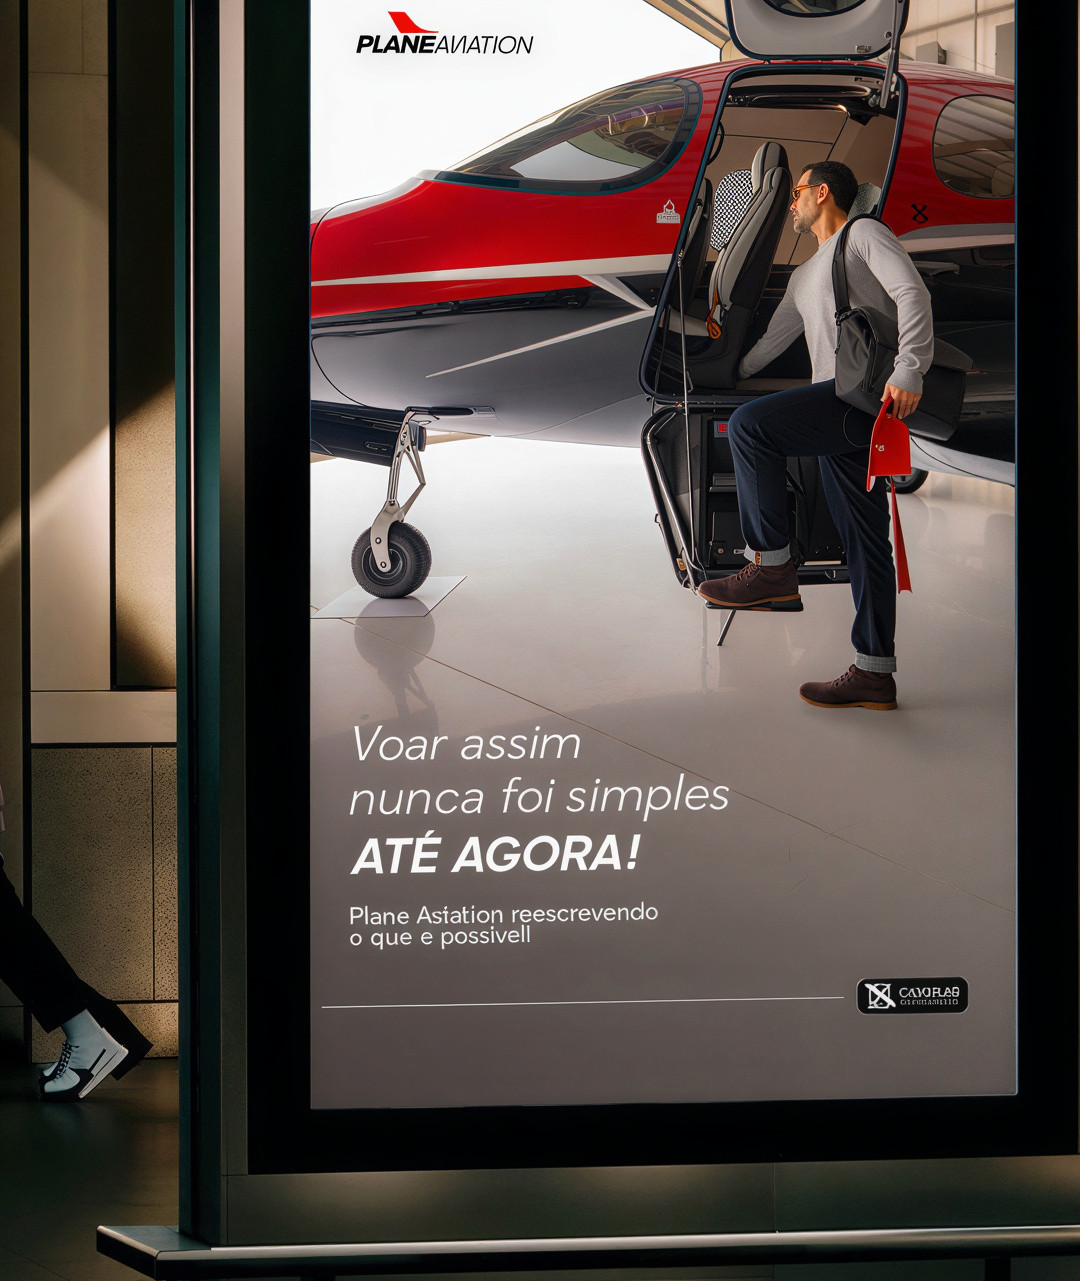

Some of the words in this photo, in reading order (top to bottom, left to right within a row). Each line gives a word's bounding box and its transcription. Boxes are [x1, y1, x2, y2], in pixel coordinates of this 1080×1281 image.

[353, 724, 449, 762] Voar
[460, 725, 581, 761] assim
[349, 788, 484, 816] nunca
[502, 776, 556, 814] foi
[565, 772, 730, 822] simples
[349, 829, 443, 875] ATÉ
[450, 833, 642, 873] AGORA!
[349, 905, 410, 926] Plane
[511, 901, 659, 923] reescrevendo
[349, 932, 363, 946] o
[370, 931, 413, 950] que
[420, 931, 433, 945] e
[441, 924, 531, 950] possivell
